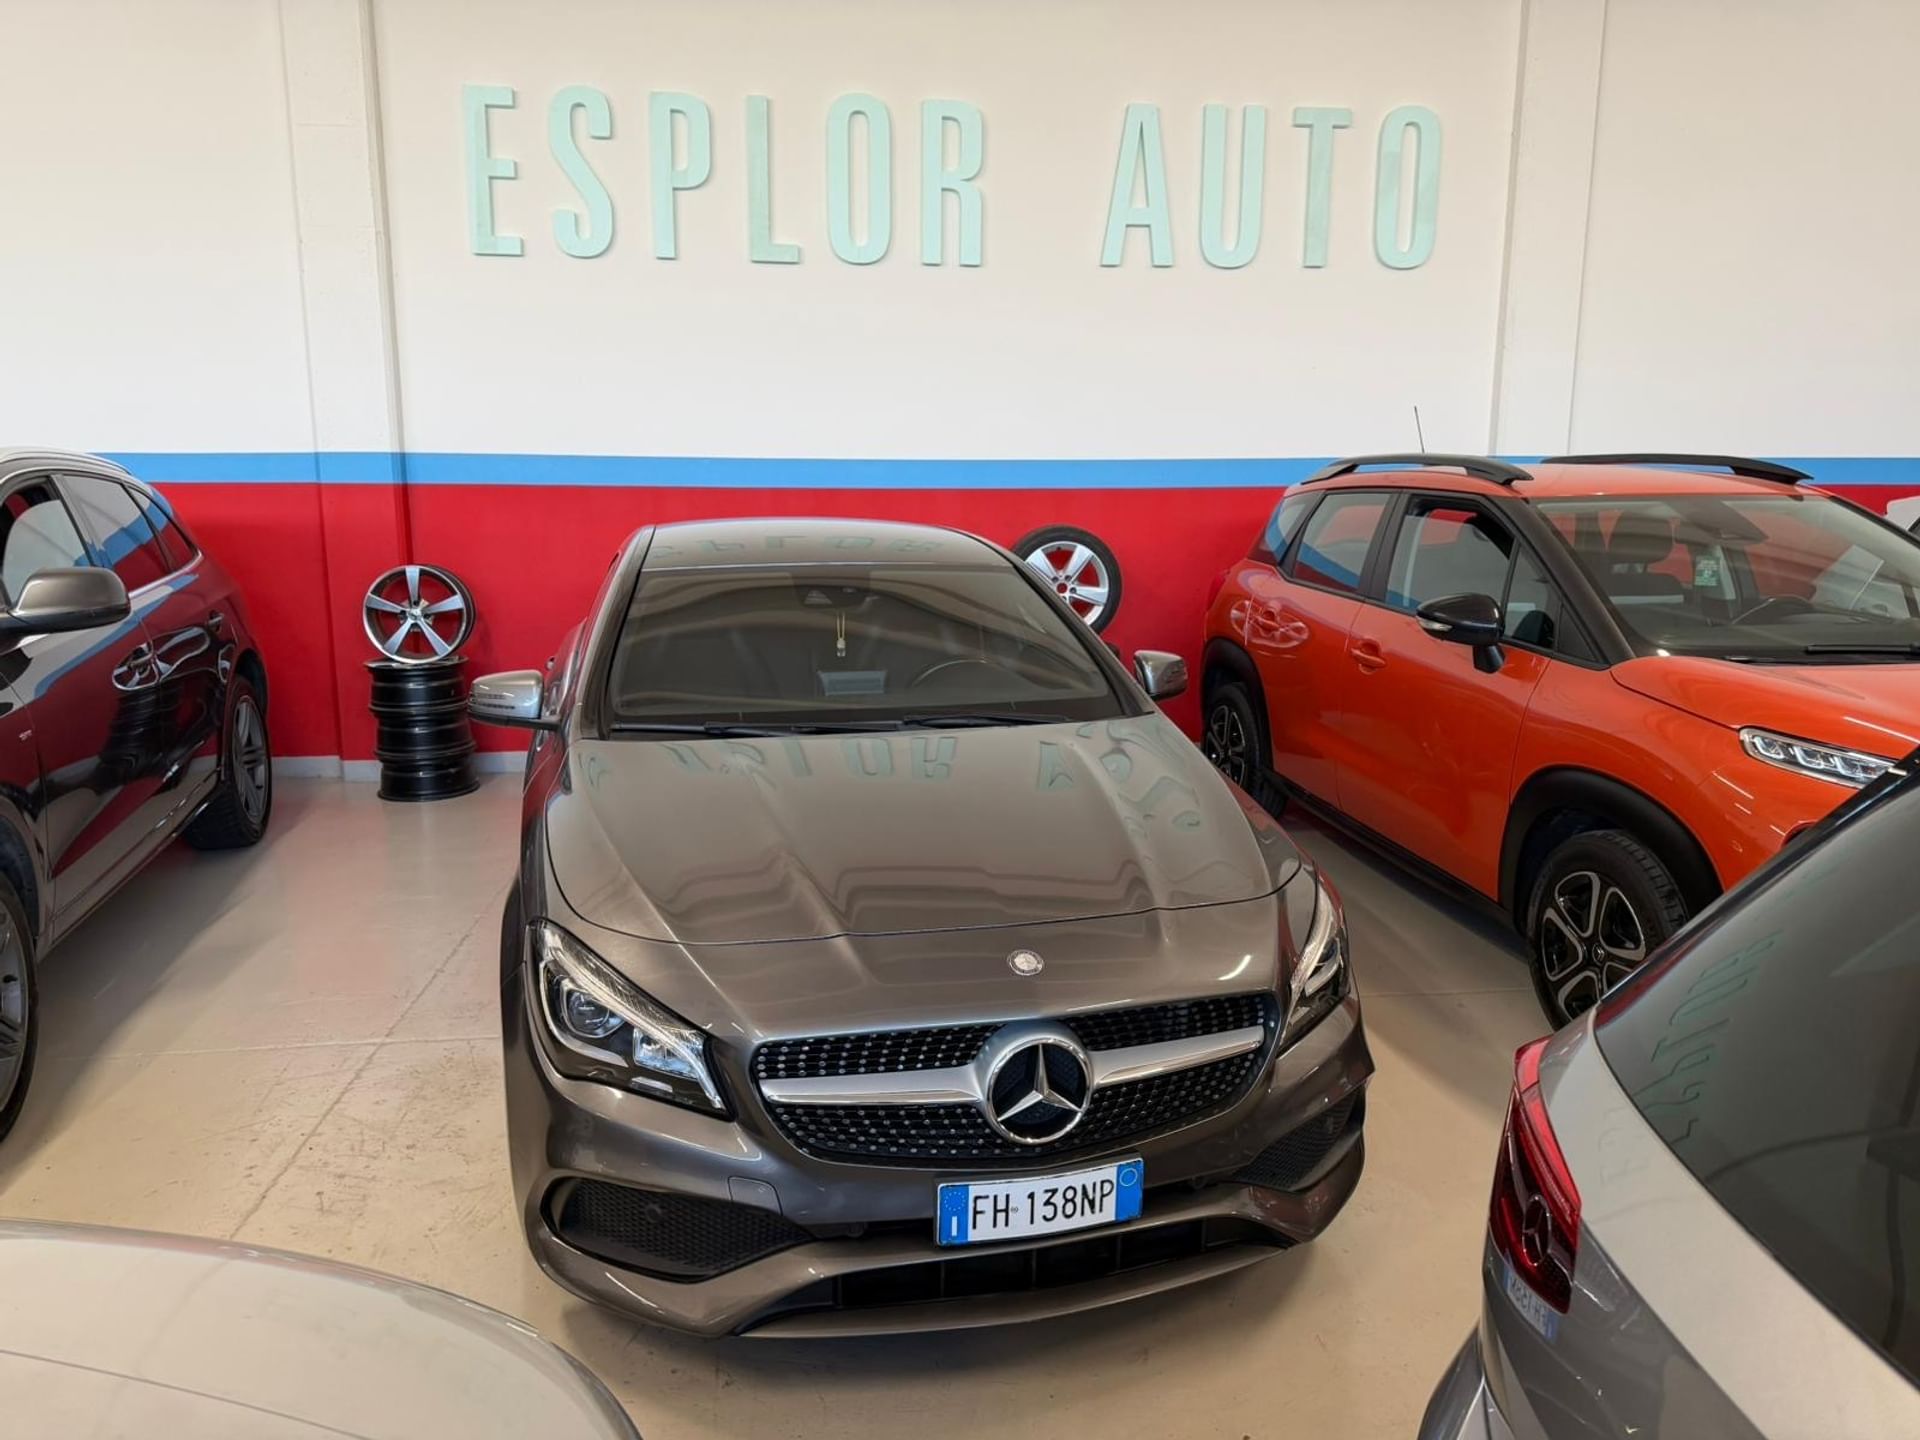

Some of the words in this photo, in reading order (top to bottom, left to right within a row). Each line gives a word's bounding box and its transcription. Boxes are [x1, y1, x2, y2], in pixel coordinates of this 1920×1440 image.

[462, 84, 986, 269] ESPLOR
[1099, 103, 1442, 270] AUTO
[971, 1193, 1011, 1230] FH
[1026, 1179, 1115, 1225] 138NP
